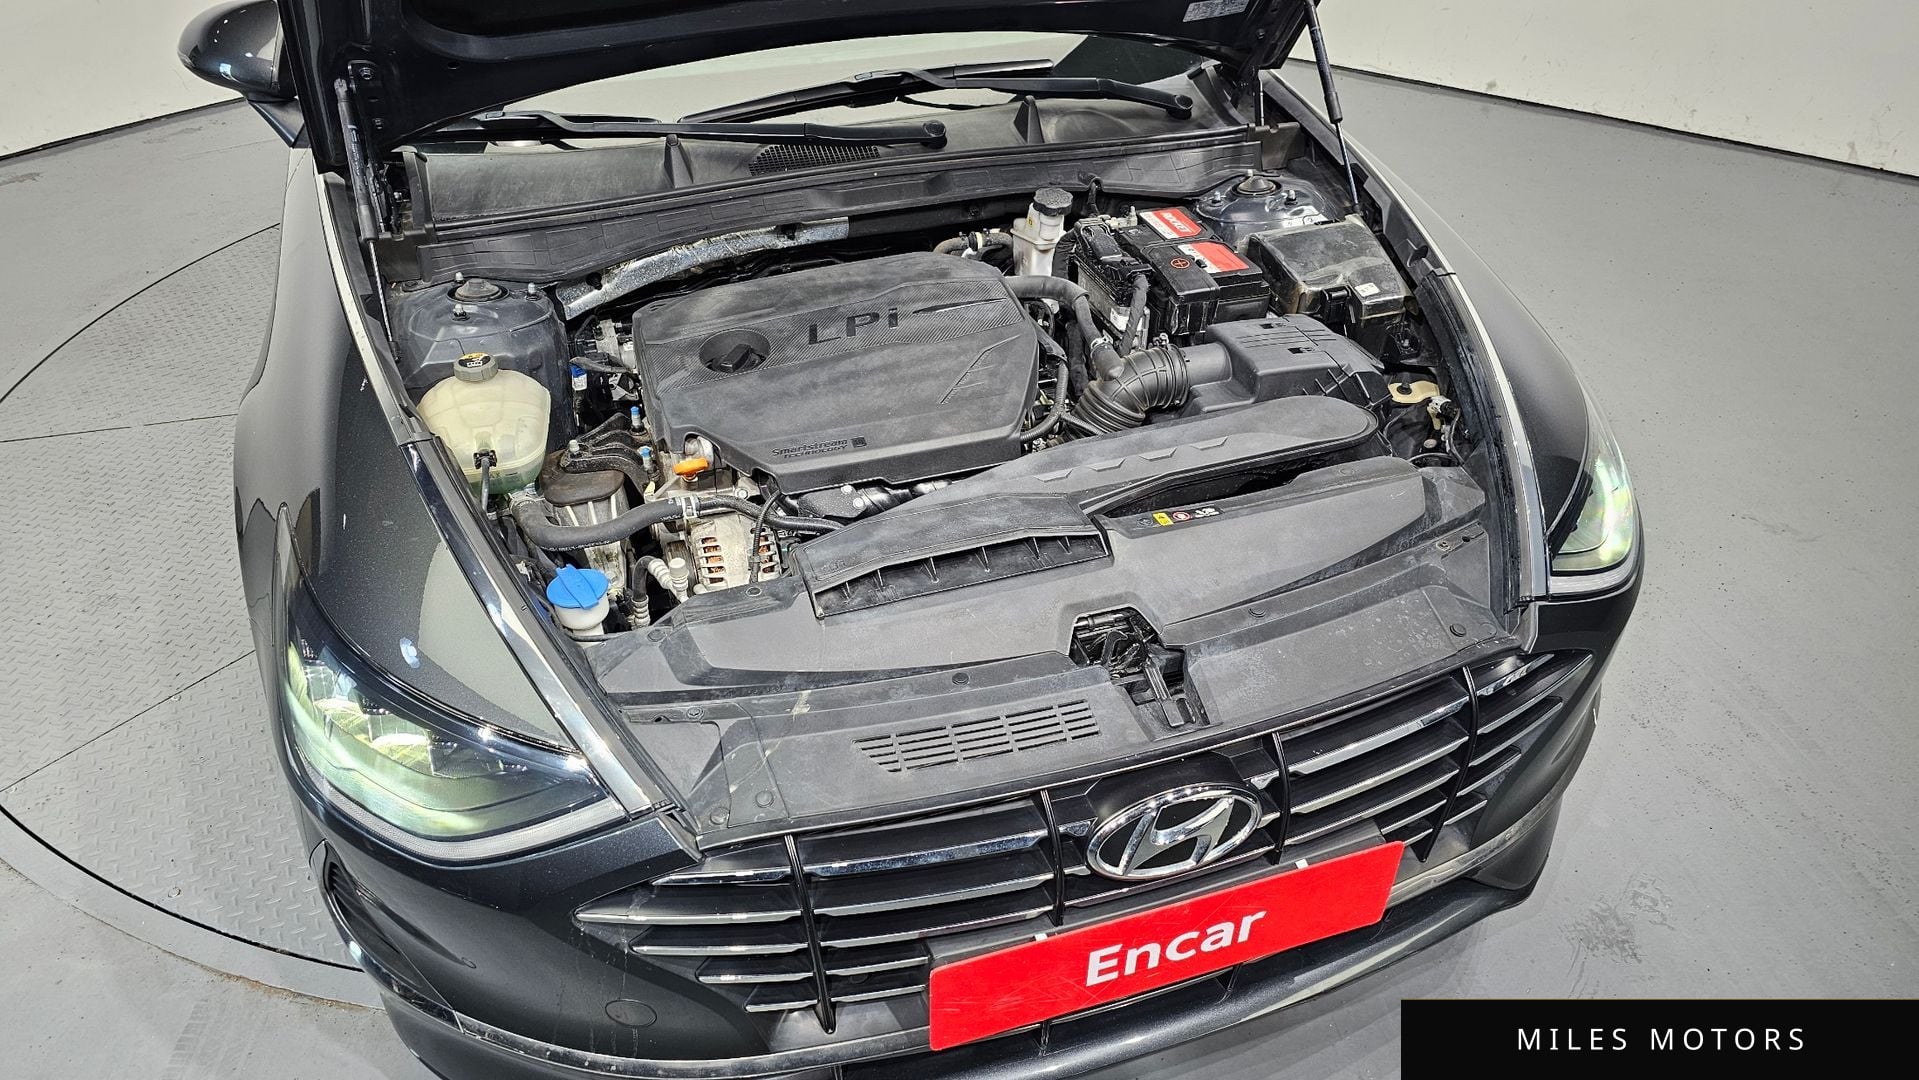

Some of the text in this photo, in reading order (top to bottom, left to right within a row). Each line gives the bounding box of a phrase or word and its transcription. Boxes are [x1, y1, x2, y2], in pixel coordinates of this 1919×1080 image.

[808, 307, 898, 345] LPi
[772, 439, 848, 456] Smartstream
[1086, 910, 1267, 987] Encar
